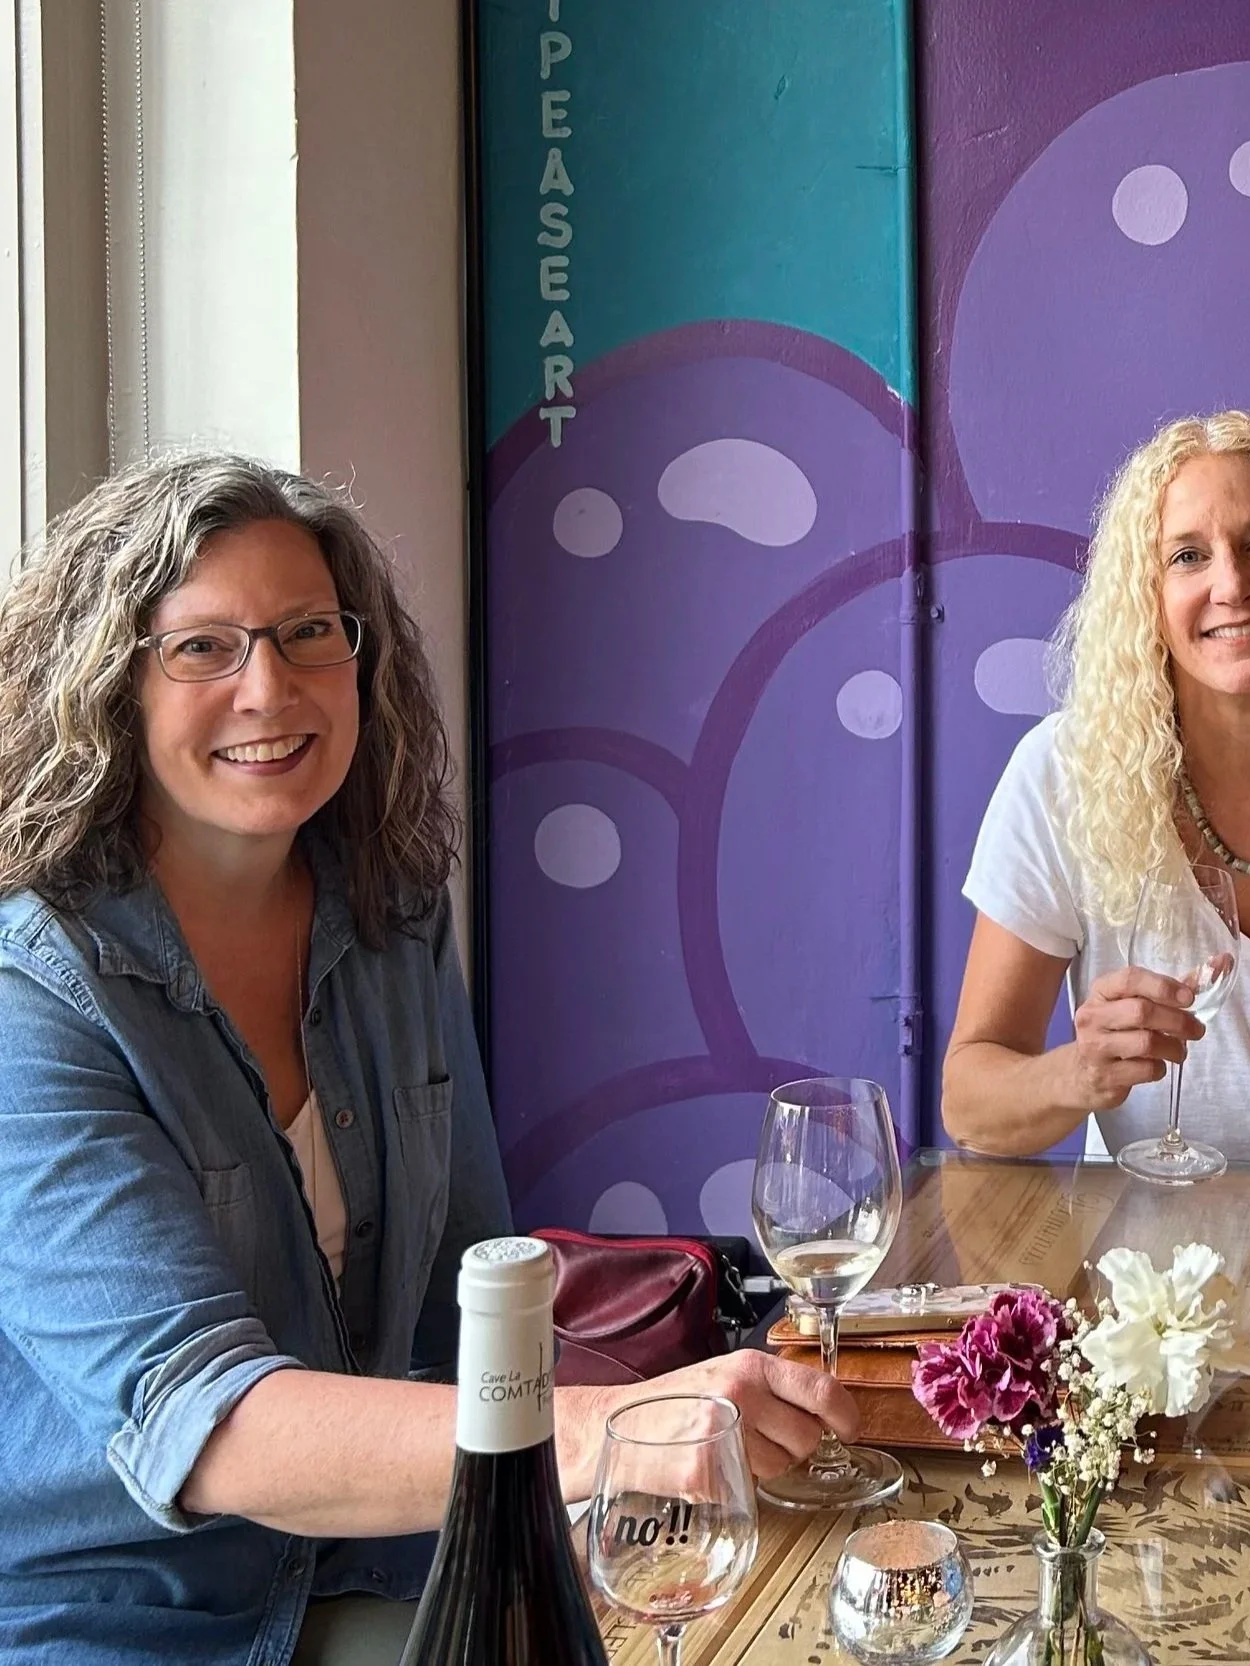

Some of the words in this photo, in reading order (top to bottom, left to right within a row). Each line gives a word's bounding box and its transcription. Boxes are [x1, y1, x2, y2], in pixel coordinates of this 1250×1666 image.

[479, 1372, 552, 1402] COMTAD
[481, 1371, 507, 1384] Cave
[508, 1370, 521, 1382] La
